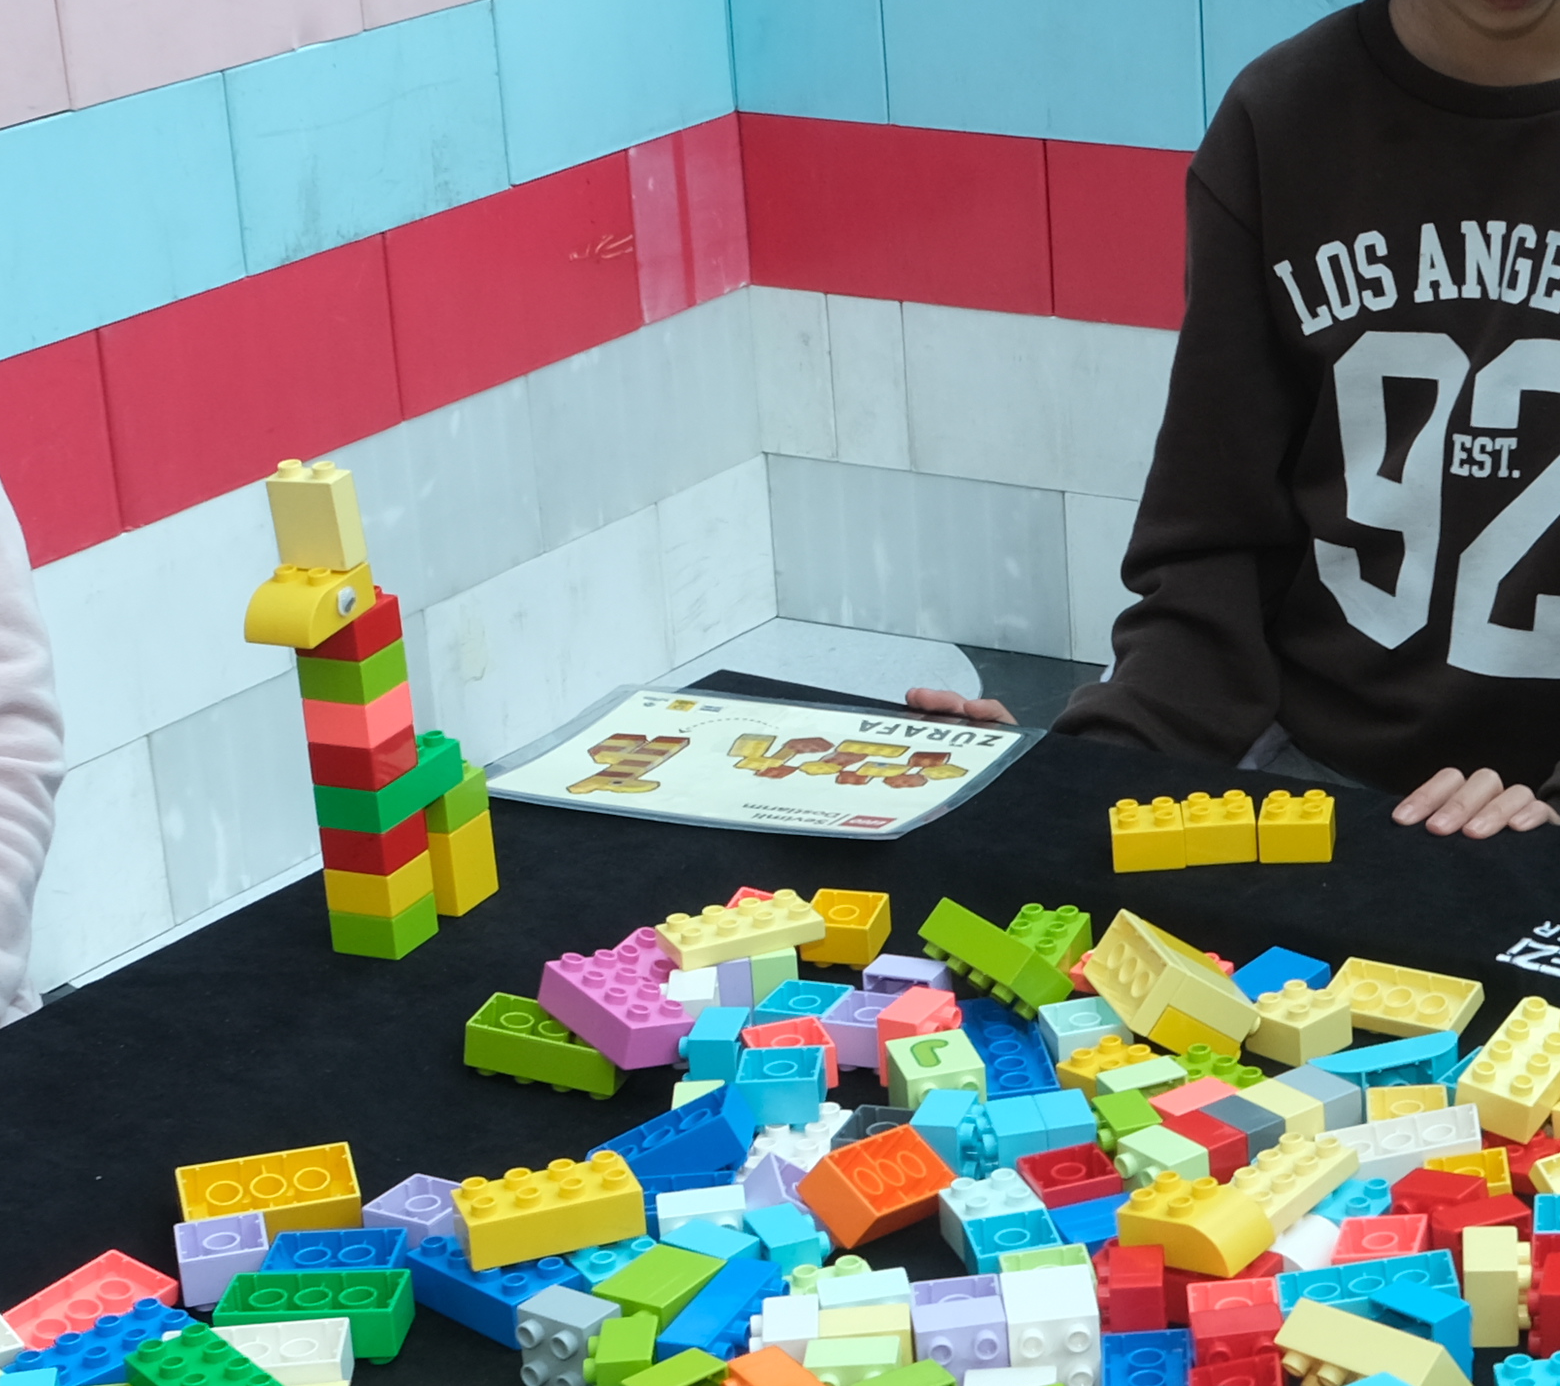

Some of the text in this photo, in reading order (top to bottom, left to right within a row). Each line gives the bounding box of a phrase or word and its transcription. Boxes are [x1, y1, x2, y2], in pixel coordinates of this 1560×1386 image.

[1273, 230, 1399, 336] LOS
[1450, 433, 1521, 478] EST.
[858, 719, 1005, 748] ZÜRAFA
